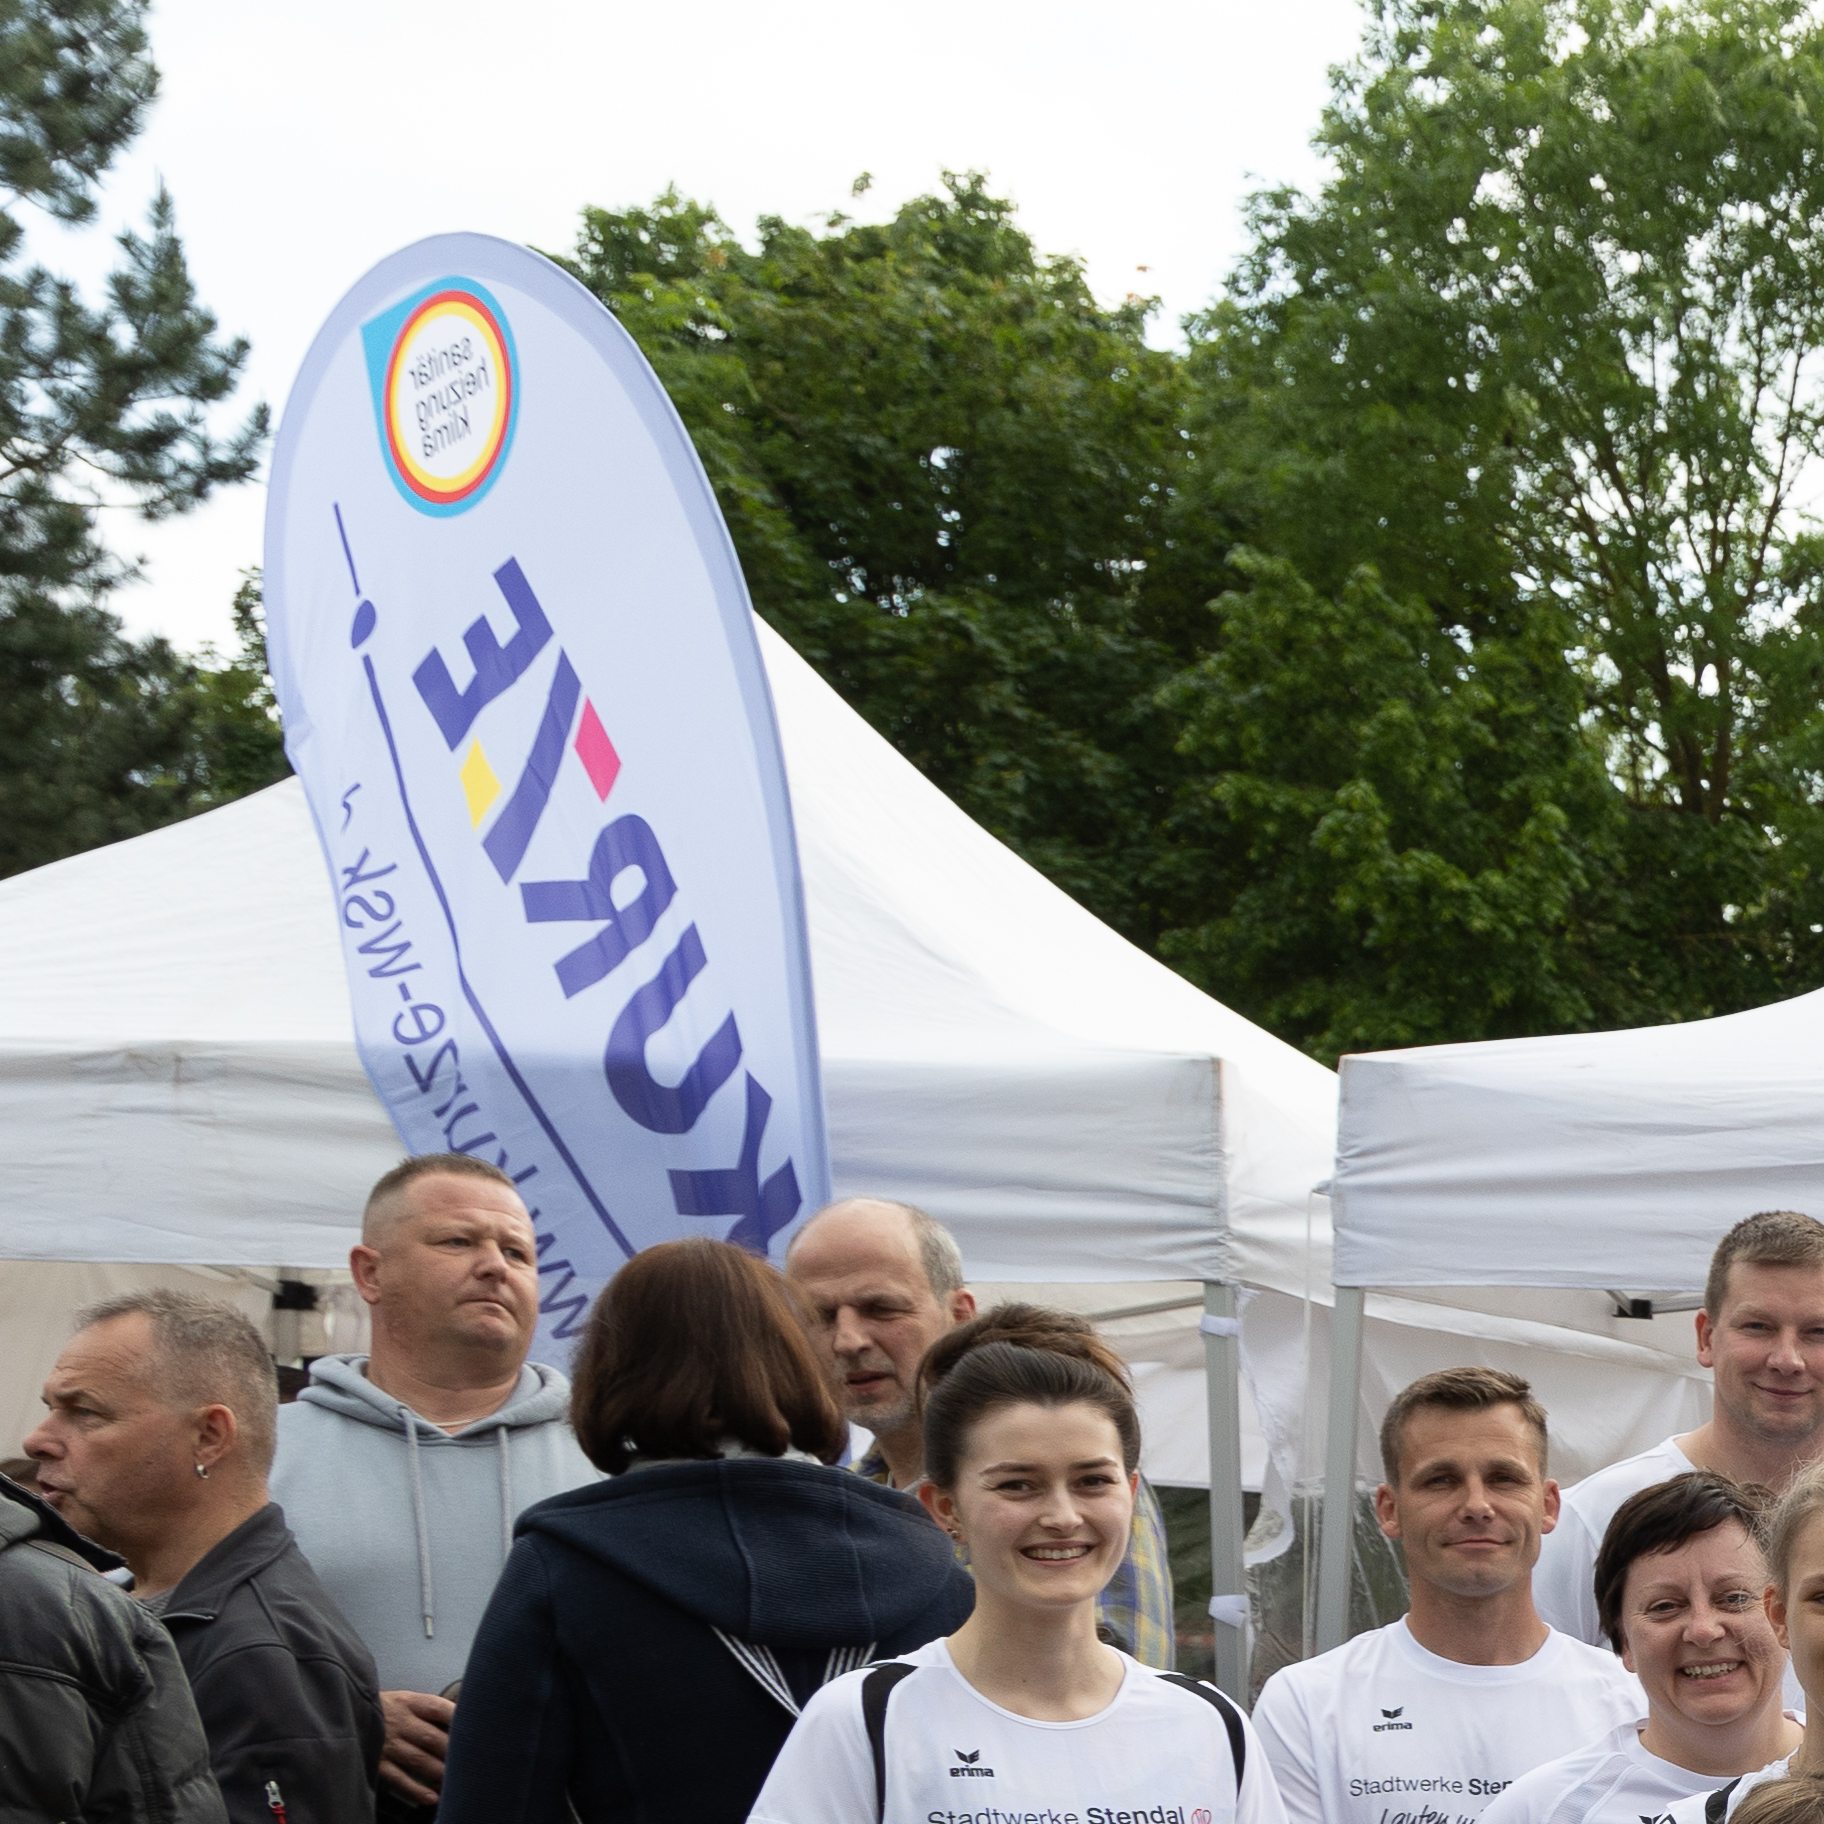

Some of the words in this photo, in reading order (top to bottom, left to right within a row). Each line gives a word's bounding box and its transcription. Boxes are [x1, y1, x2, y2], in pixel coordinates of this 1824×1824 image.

[1373, 1720, 1413, 1733] erima
[950, 1764, 994, 1778] erima
[1349, 1775, 1463, 1797] Stadtwerke
